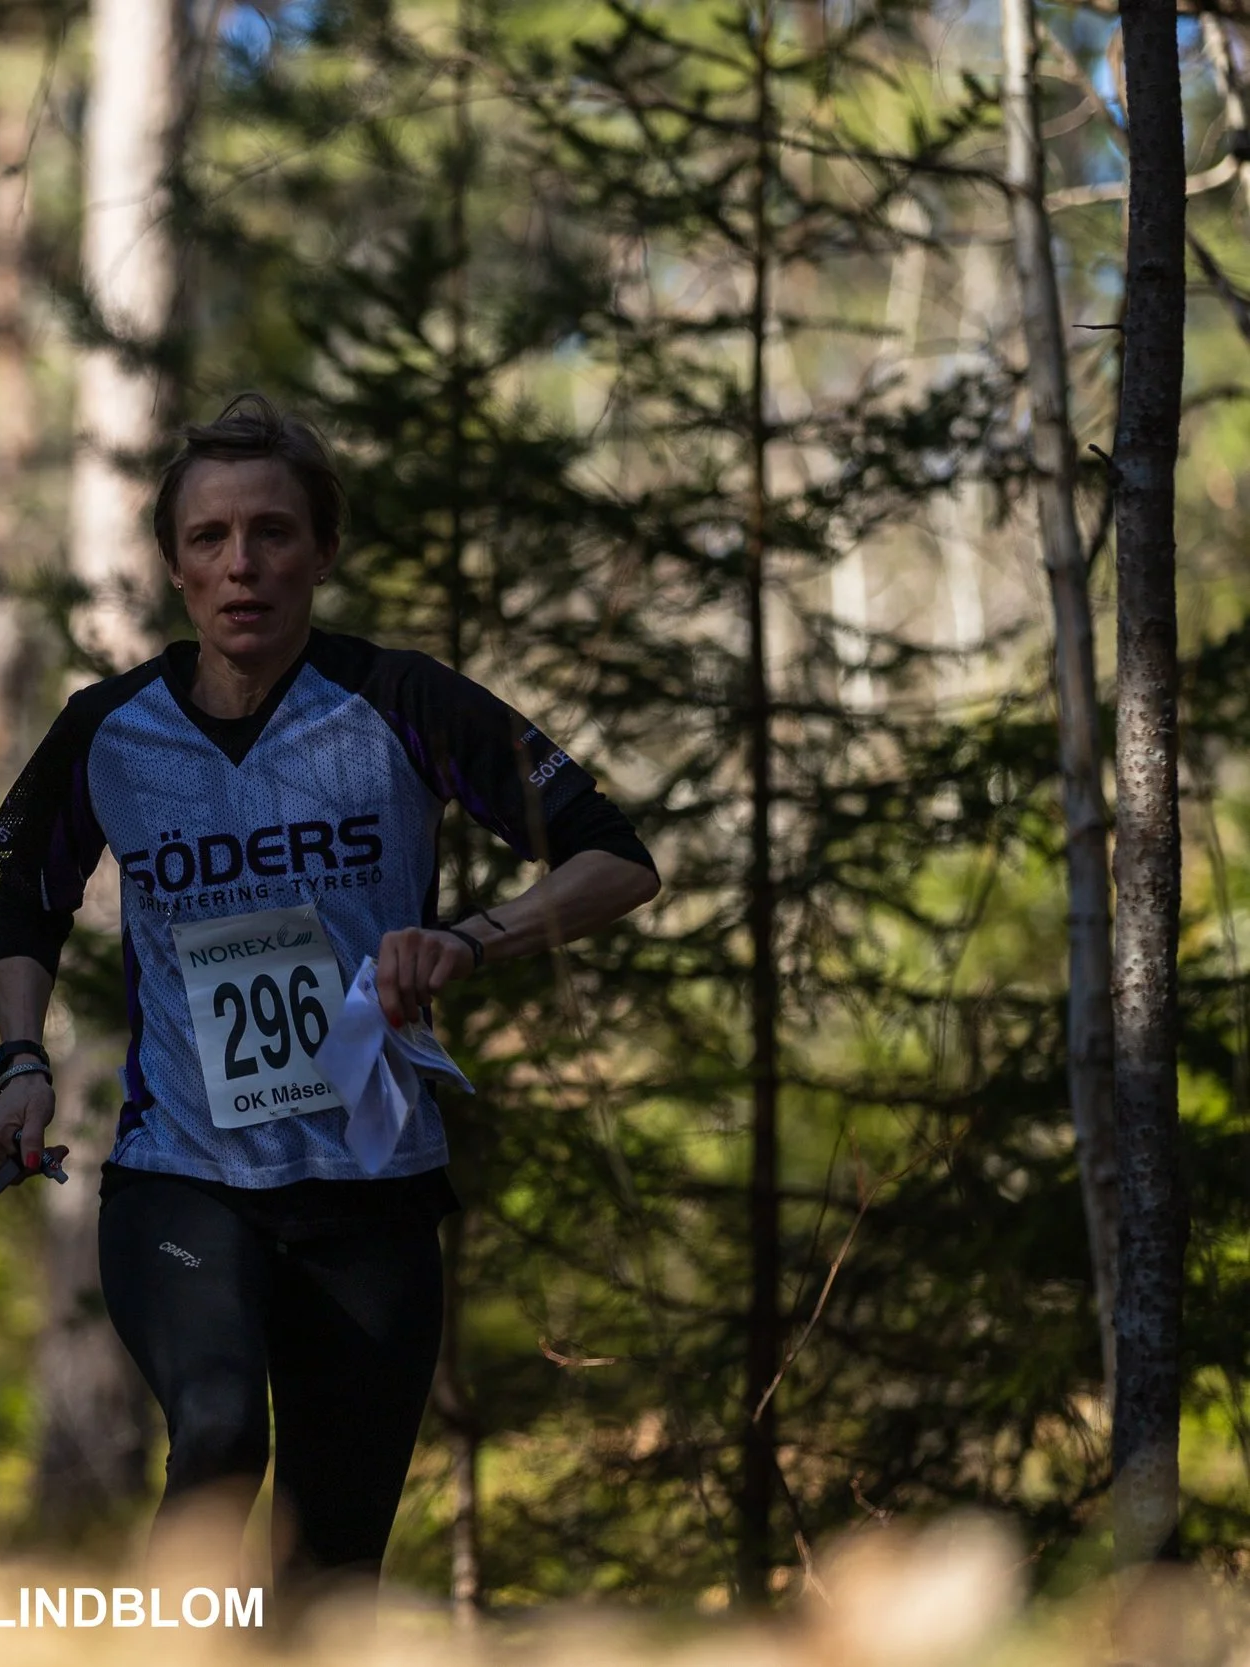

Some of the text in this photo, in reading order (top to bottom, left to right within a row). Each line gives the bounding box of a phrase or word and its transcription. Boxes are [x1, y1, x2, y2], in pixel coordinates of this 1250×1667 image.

[122, 814, 383, 895] SÖDERS
[290, 867, 383, 894] TYRESÖ
[189, 936, 277, 968] NOREX
[213, 965, 330, 1081] 296
[234, 1090, 267, 1113] OK
[159, 1241, 196, 1261] CRAFT
